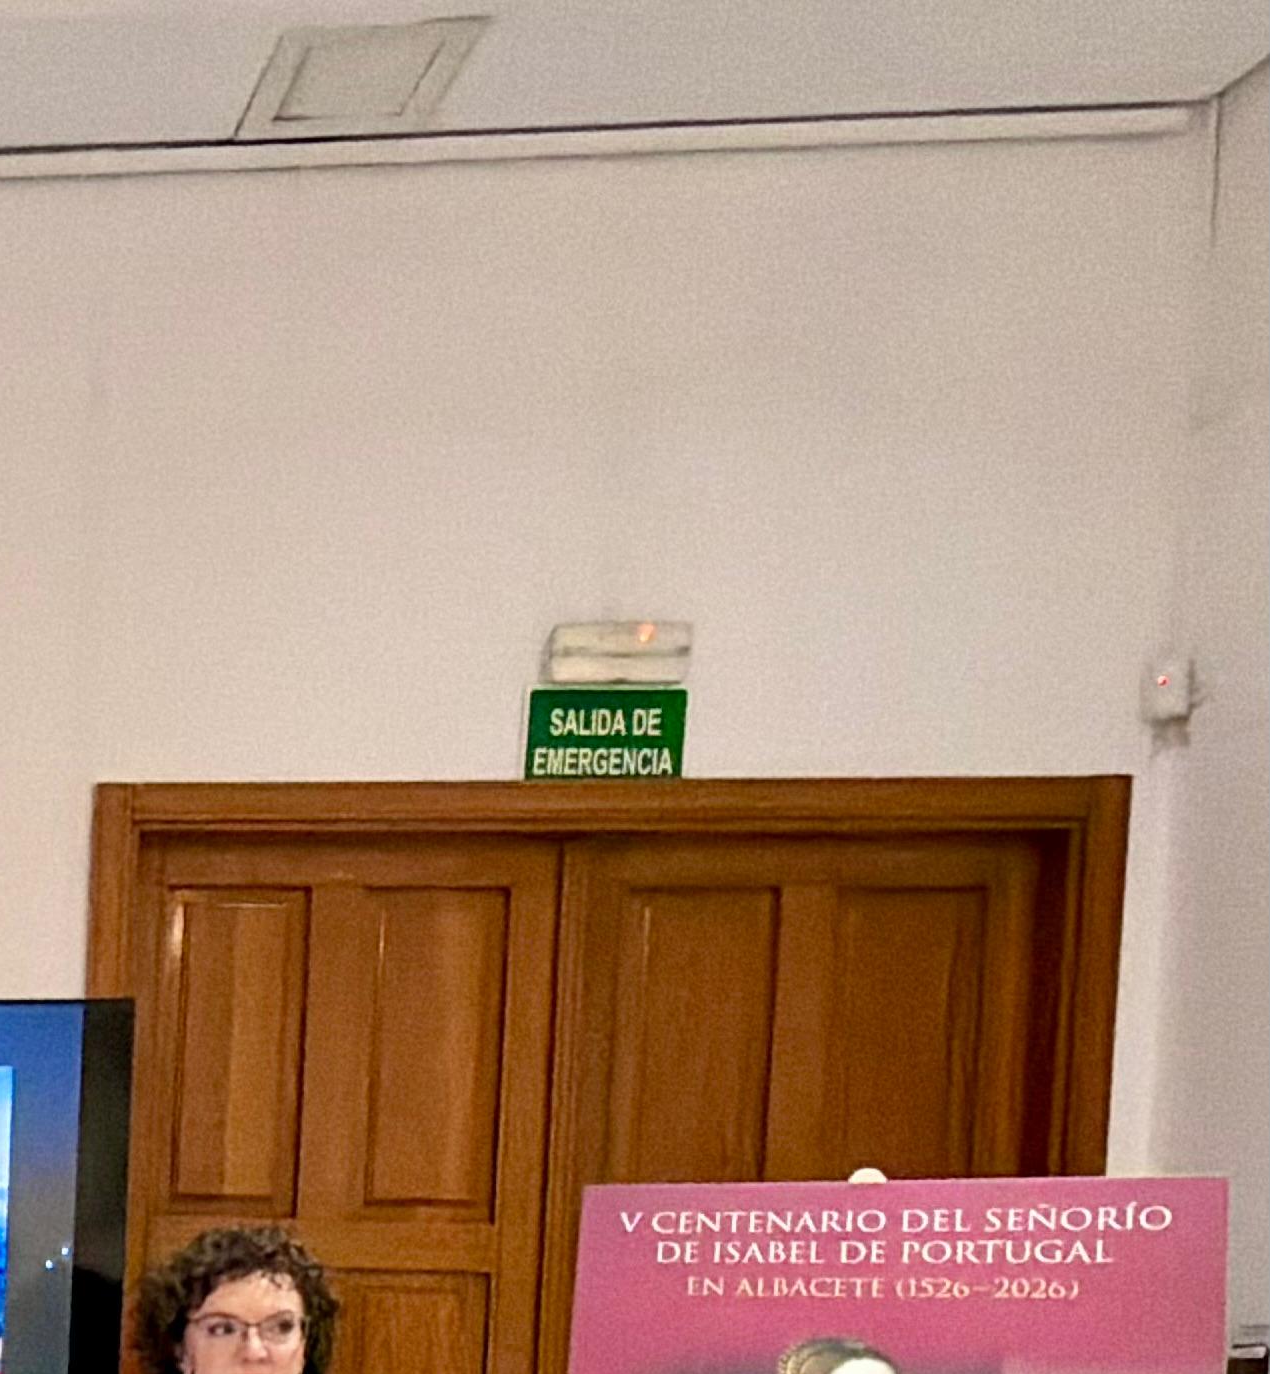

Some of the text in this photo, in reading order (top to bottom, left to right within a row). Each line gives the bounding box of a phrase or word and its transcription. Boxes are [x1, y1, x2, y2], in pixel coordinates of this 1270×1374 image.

[549, 708, 662, 736] SALIDA DE
[533, 748, 673, 775] EMERGENCIA
[620, 1201, 1173, 1234] V CENTENARIO DEL SEÑORÍO
[656, 1239, 1114, 1264] DE ISABEL DE PORTUGAL
[687, 1276, 724, 1297] EN
[736, 1277, 885, 1298] ALBACETE
